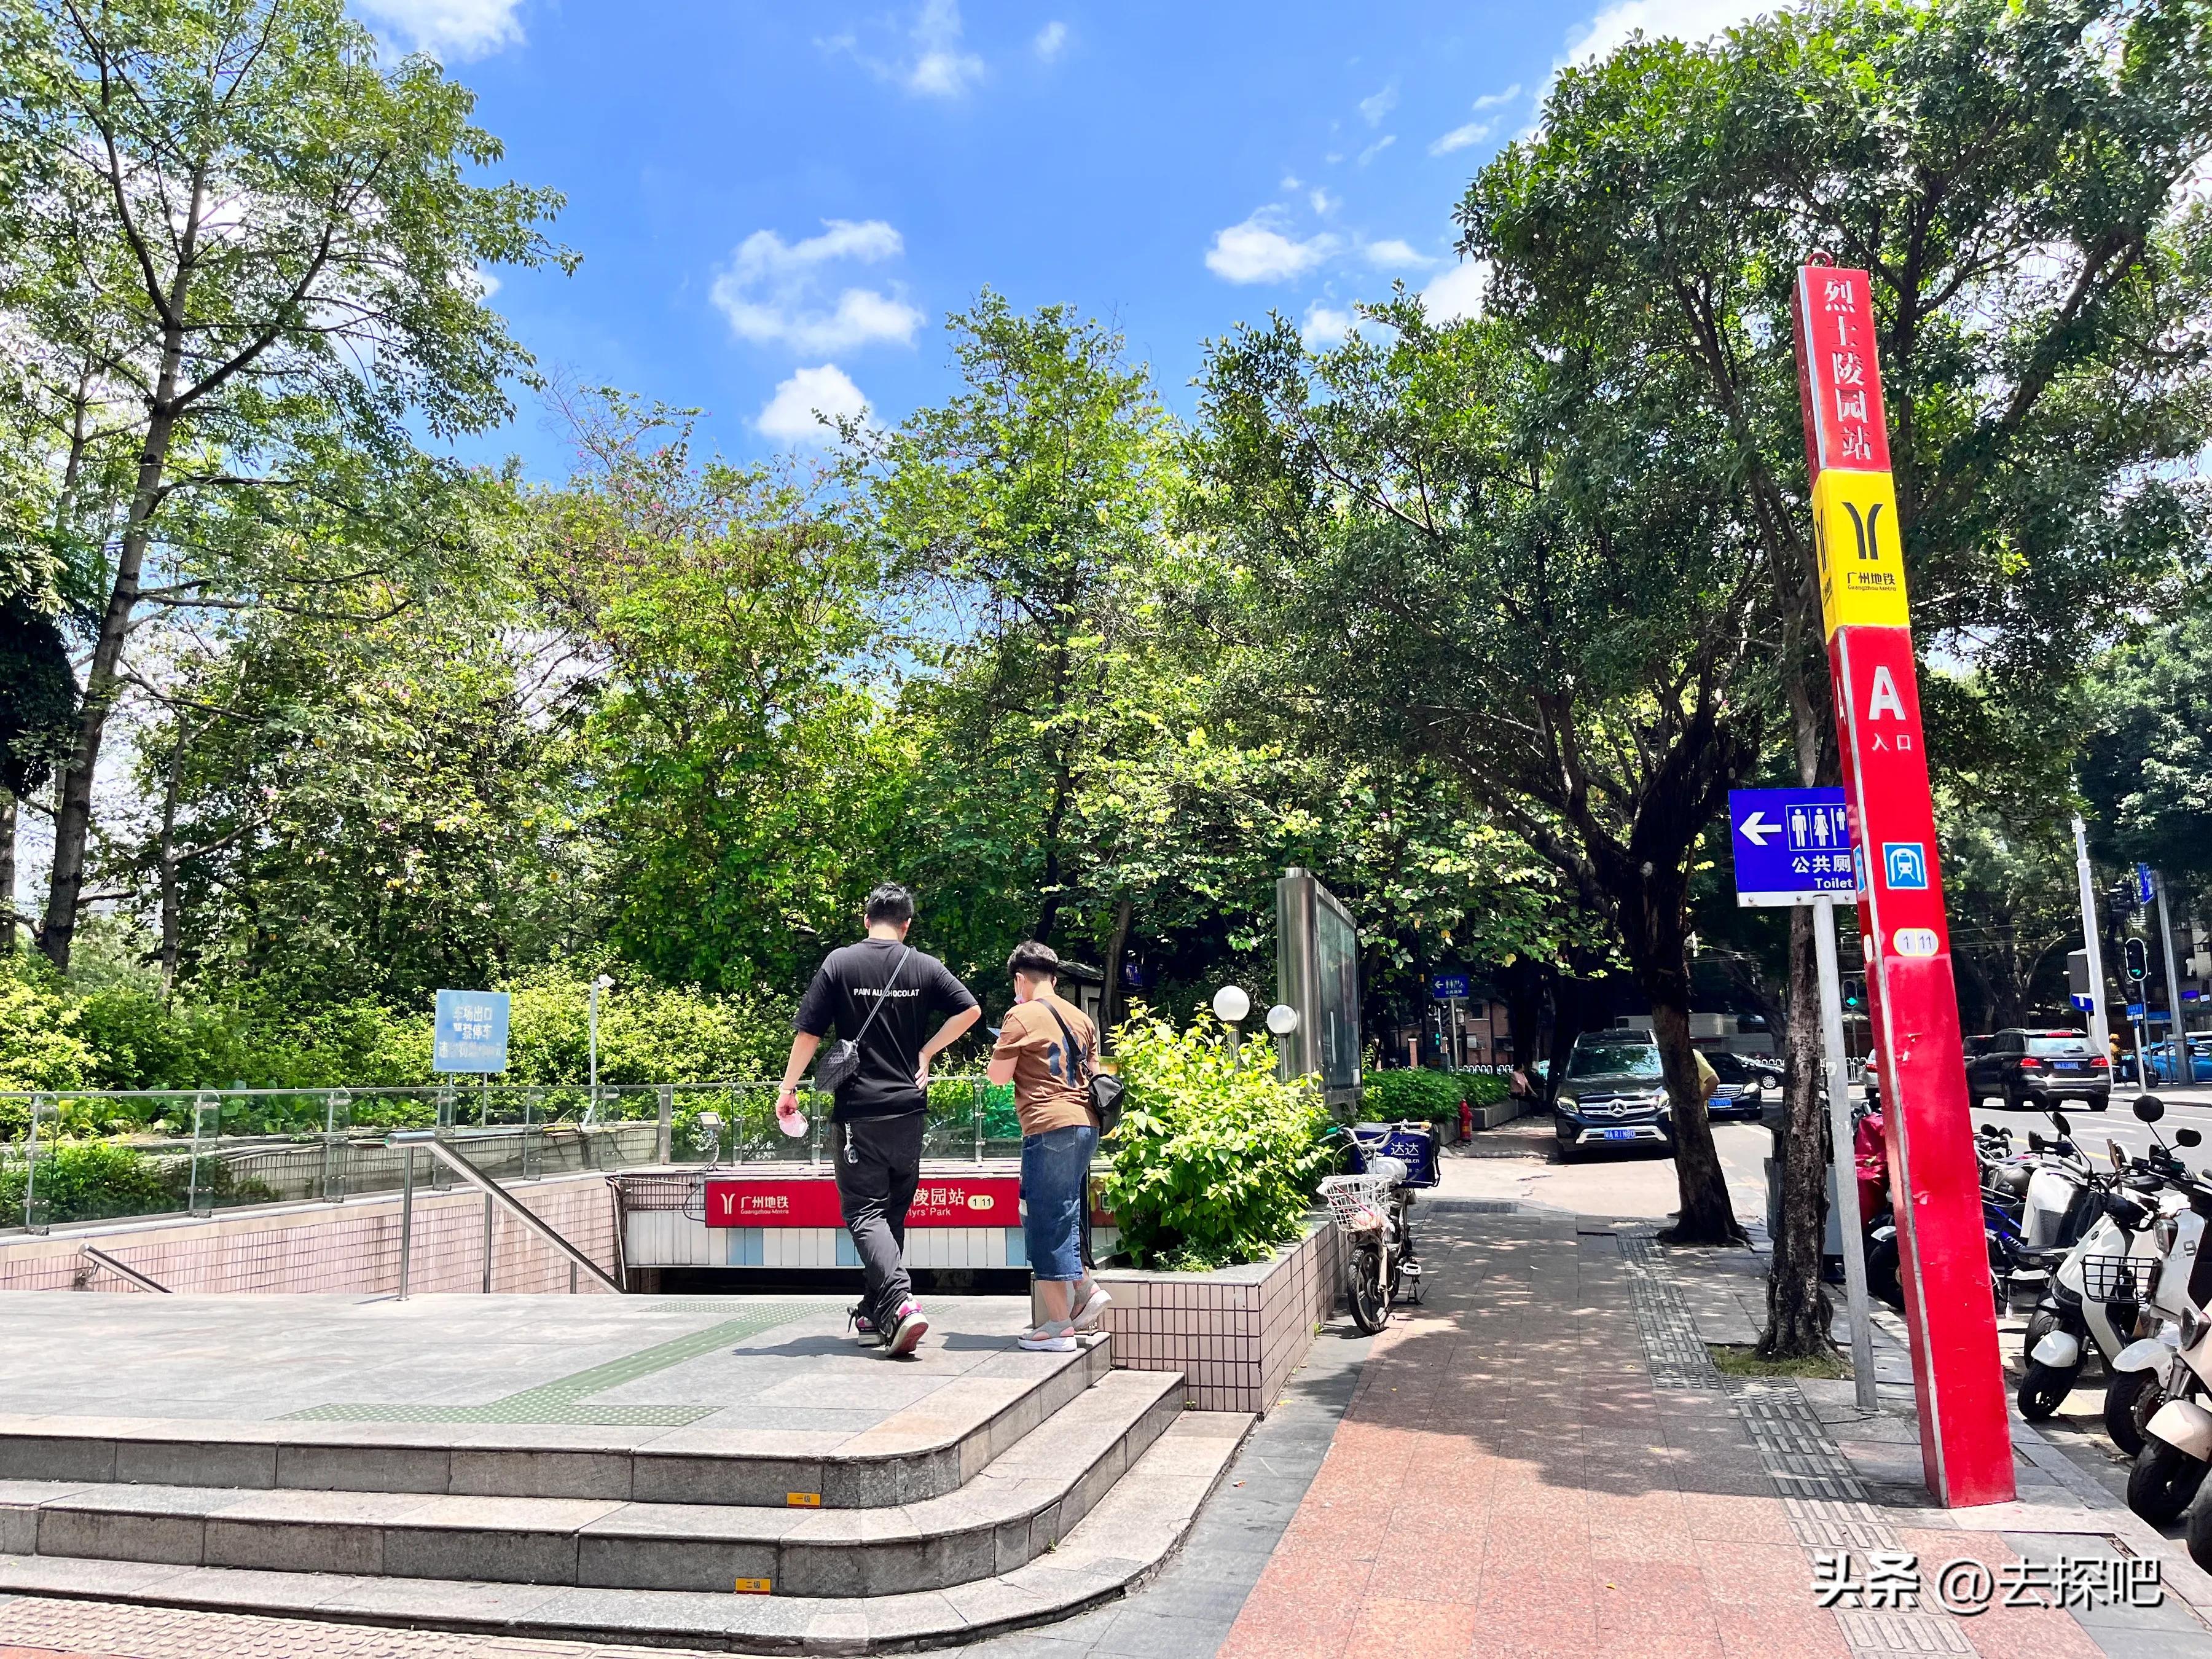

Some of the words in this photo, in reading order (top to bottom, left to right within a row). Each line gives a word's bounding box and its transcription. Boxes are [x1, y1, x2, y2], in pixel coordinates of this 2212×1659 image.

[1824, 278, 1872, 460] 烈士陵园站
[1847, 572, 1896, 585] 广州地铁
[1869, 666, 1906, 721] A
[1872, 733, 1912, 751] 入口
[1791, 855, 1851, 874] 公共厕
[1814, 877, 1853, 888] Toilet
[1903, 935, 1910, 949] 1
[1920, 935, 1932, 949] 11
[453, 1005, 493, 1022] 车场出口
[1390, 1142, 1419, 1156] 达达
[740, 1196, 790, 1209] 广州地铁
[913, 1188, 965, 1206] 陵园站
[930, 1207, 951, 1216] Park
[746, 1580, 761, 1589] 二级
